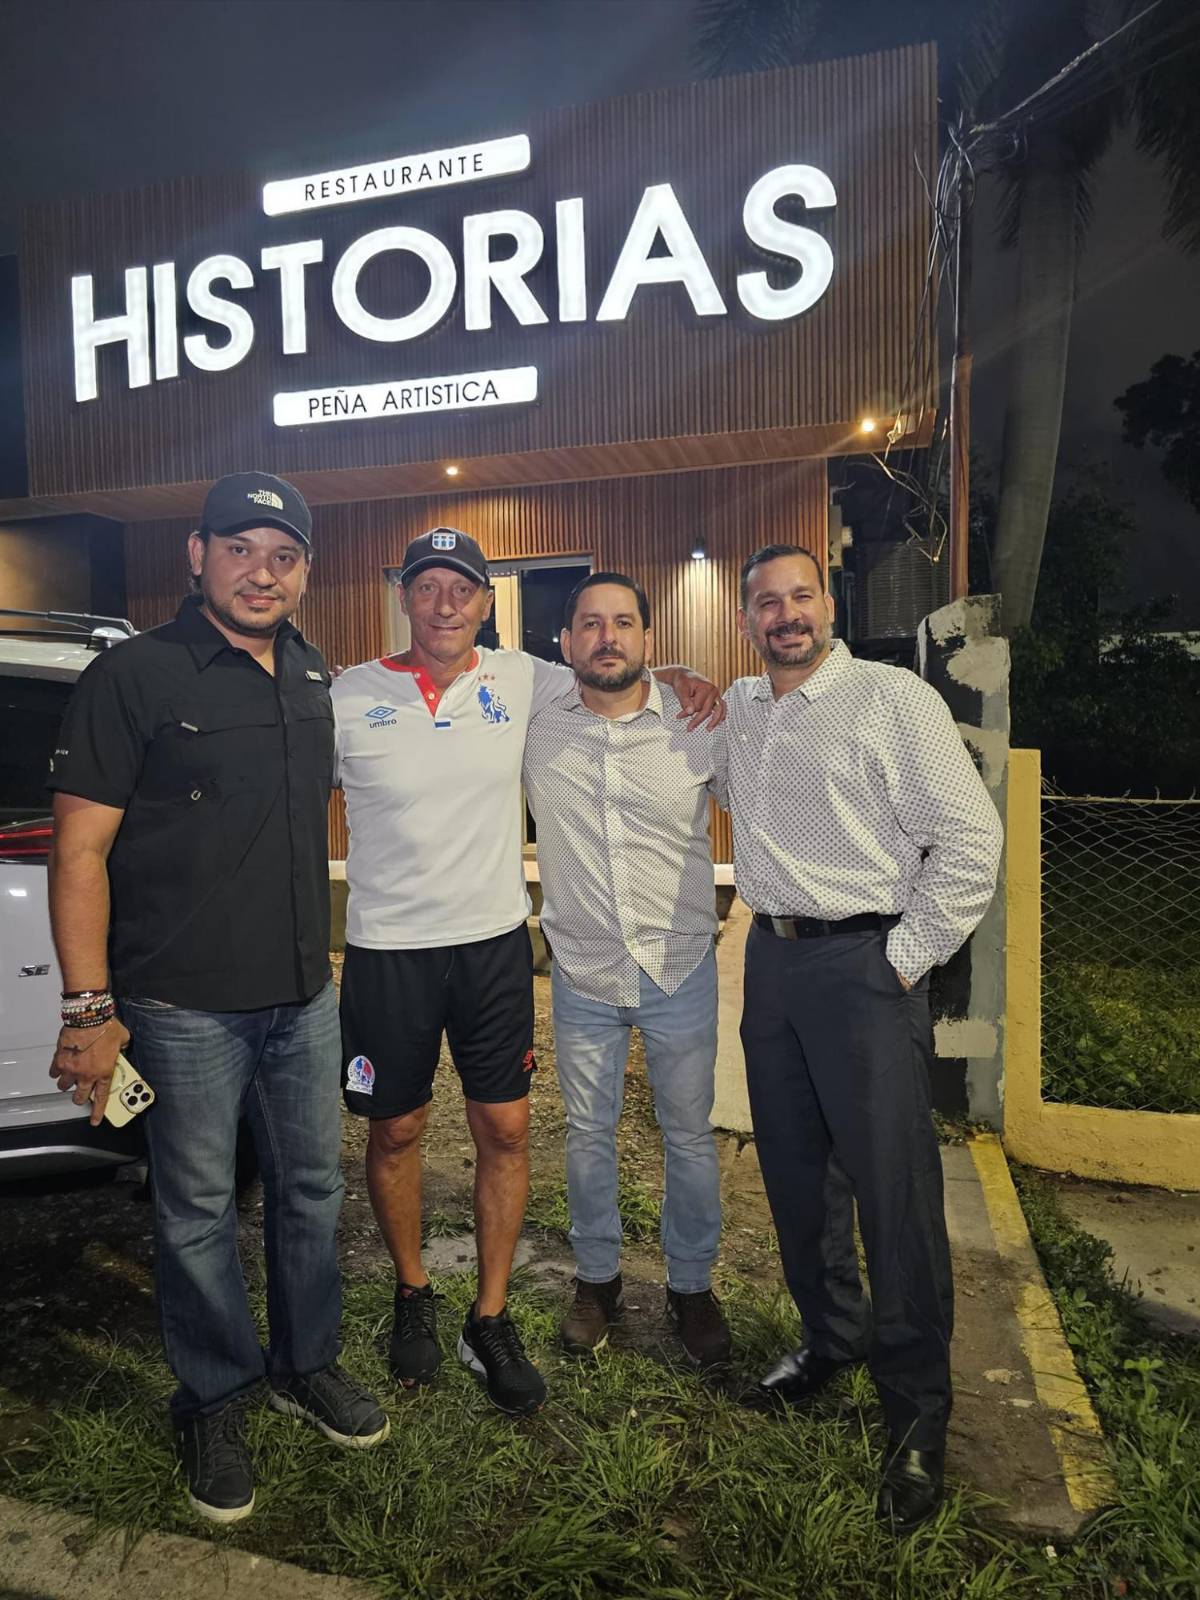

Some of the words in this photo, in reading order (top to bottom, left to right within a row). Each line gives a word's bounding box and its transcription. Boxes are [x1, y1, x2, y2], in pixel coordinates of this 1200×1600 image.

[304, 153, 484, 201] RESTAURANTE
[71, 164, 837, 403] HISTORIAS
[308, 389, 367, 418] PEÑA
[382, 379, 499, 412] ARTISTICA
[253, 498, 272, 506] FACE
[369, 718, 397, 729] umbro
[18, 964, 51, 977] SE
